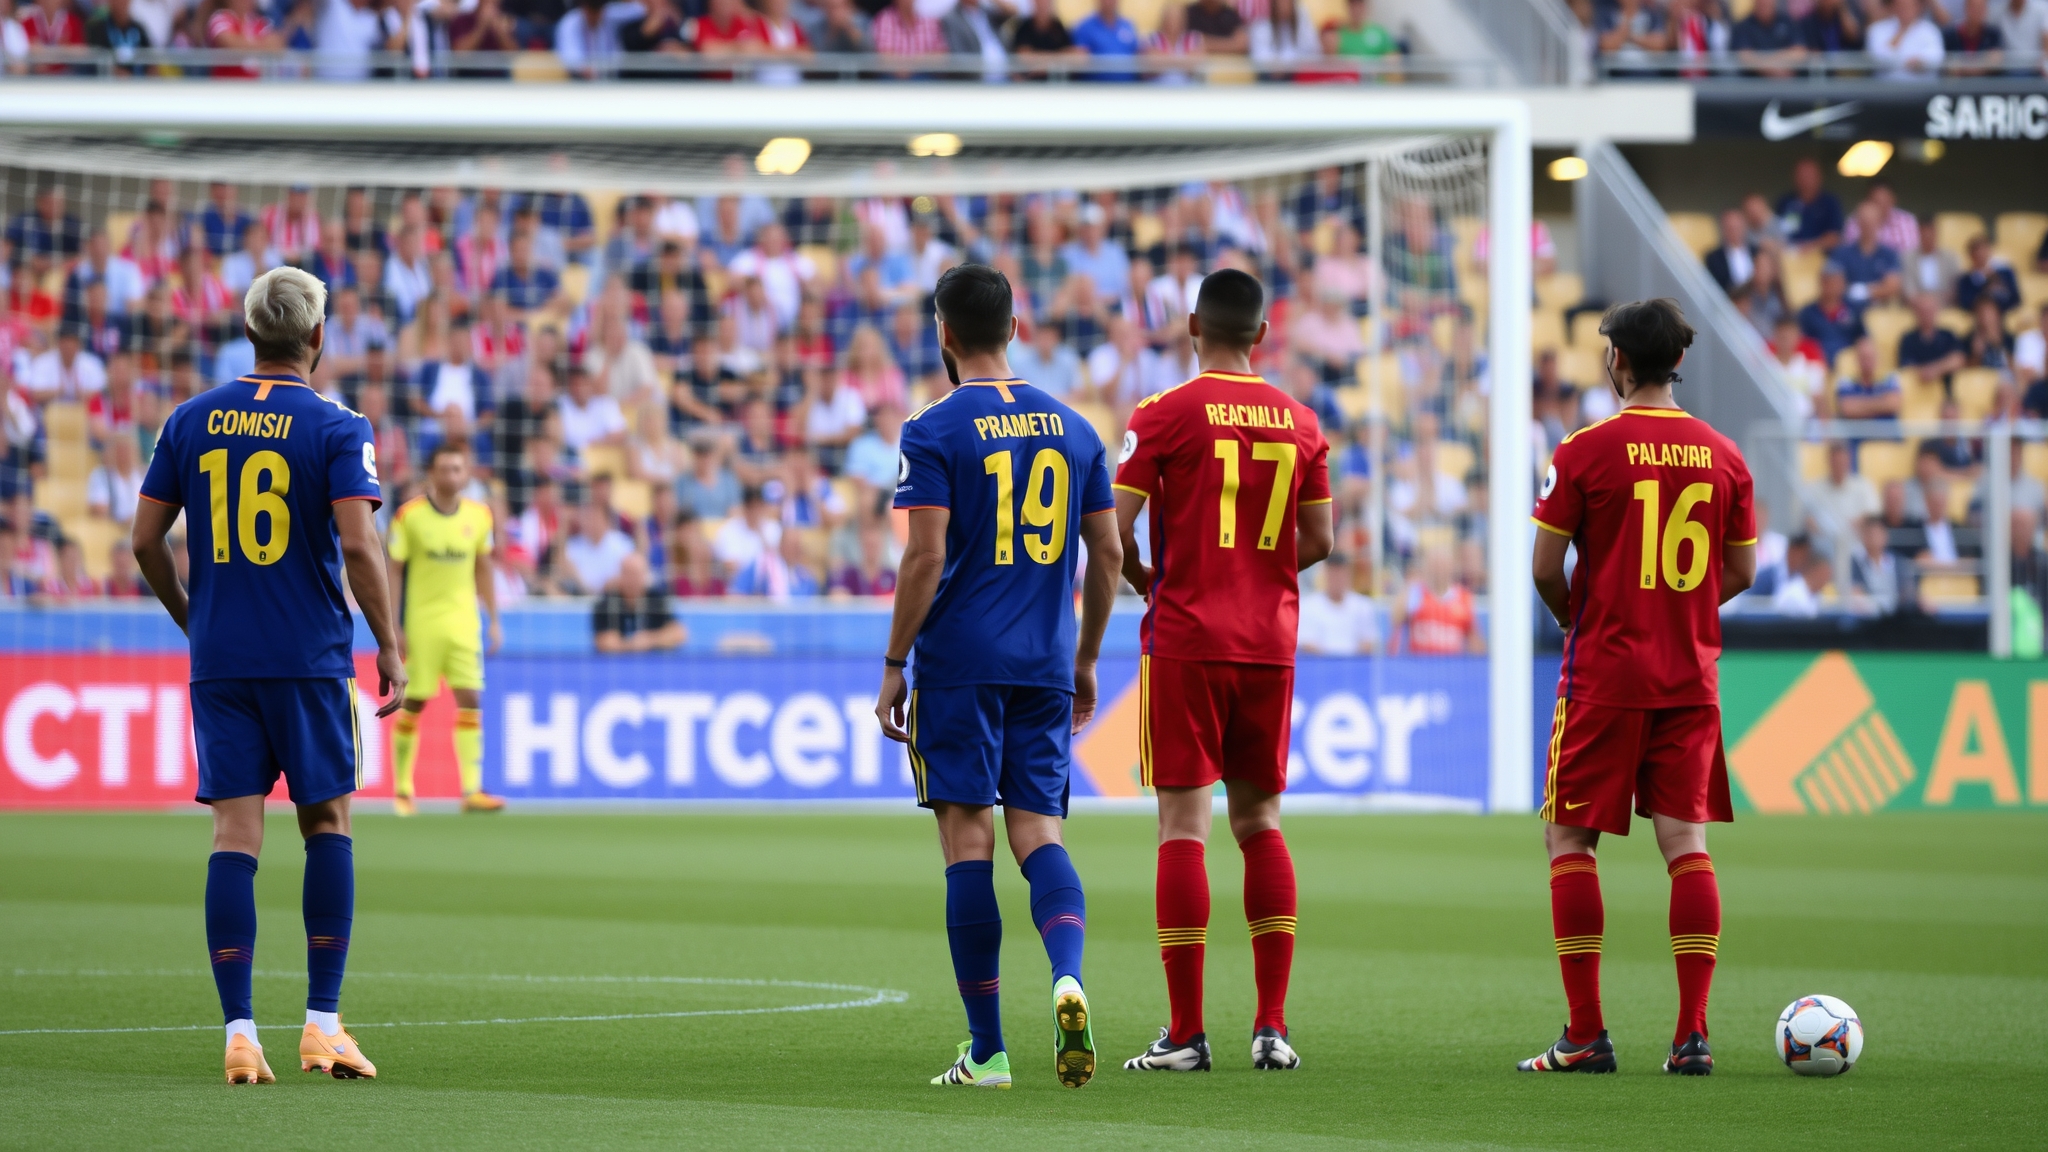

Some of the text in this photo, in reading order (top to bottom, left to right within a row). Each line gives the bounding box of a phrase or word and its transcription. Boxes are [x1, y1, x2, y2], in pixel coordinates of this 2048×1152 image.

[199, 448, 291, 566] 16
[983, 448, 1070, 565] 19
[1214, 439, 1297, 551] 17
[1633, 479, 1714, 592] 16
